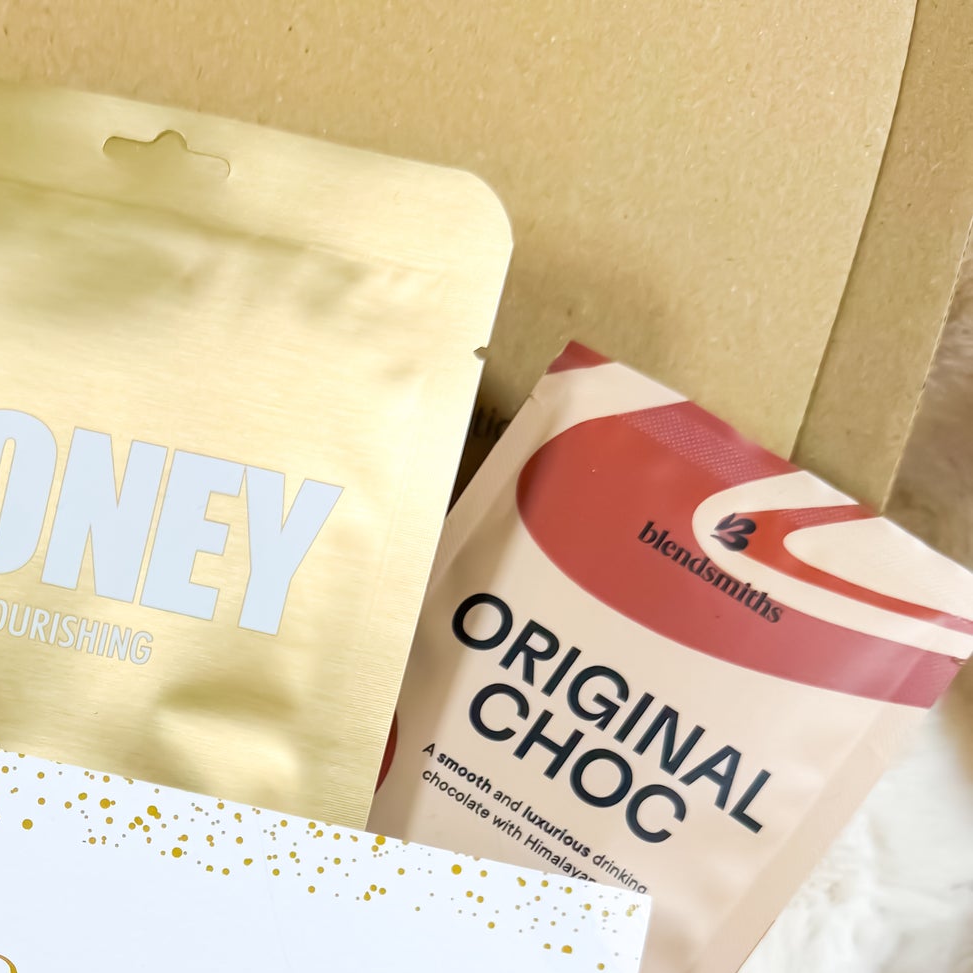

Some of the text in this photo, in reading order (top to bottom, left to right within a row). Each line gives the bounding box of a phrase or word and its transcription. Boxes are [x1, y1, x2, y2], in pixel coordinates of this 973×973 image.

[637, 520, 784, 624] blendsmiths
[451, 592, 772, 835] ORIGINAL
[468, 682, 688, 844] CHOC
[422, 743, 436, 757] A
[437, 753, 493, 794] smooth
[493, 789, 524, 812] and
[522, 805, 592, 858] luxurious
[422, 769, 490, 819] chocolate
[492, 814, 524, 841] with
